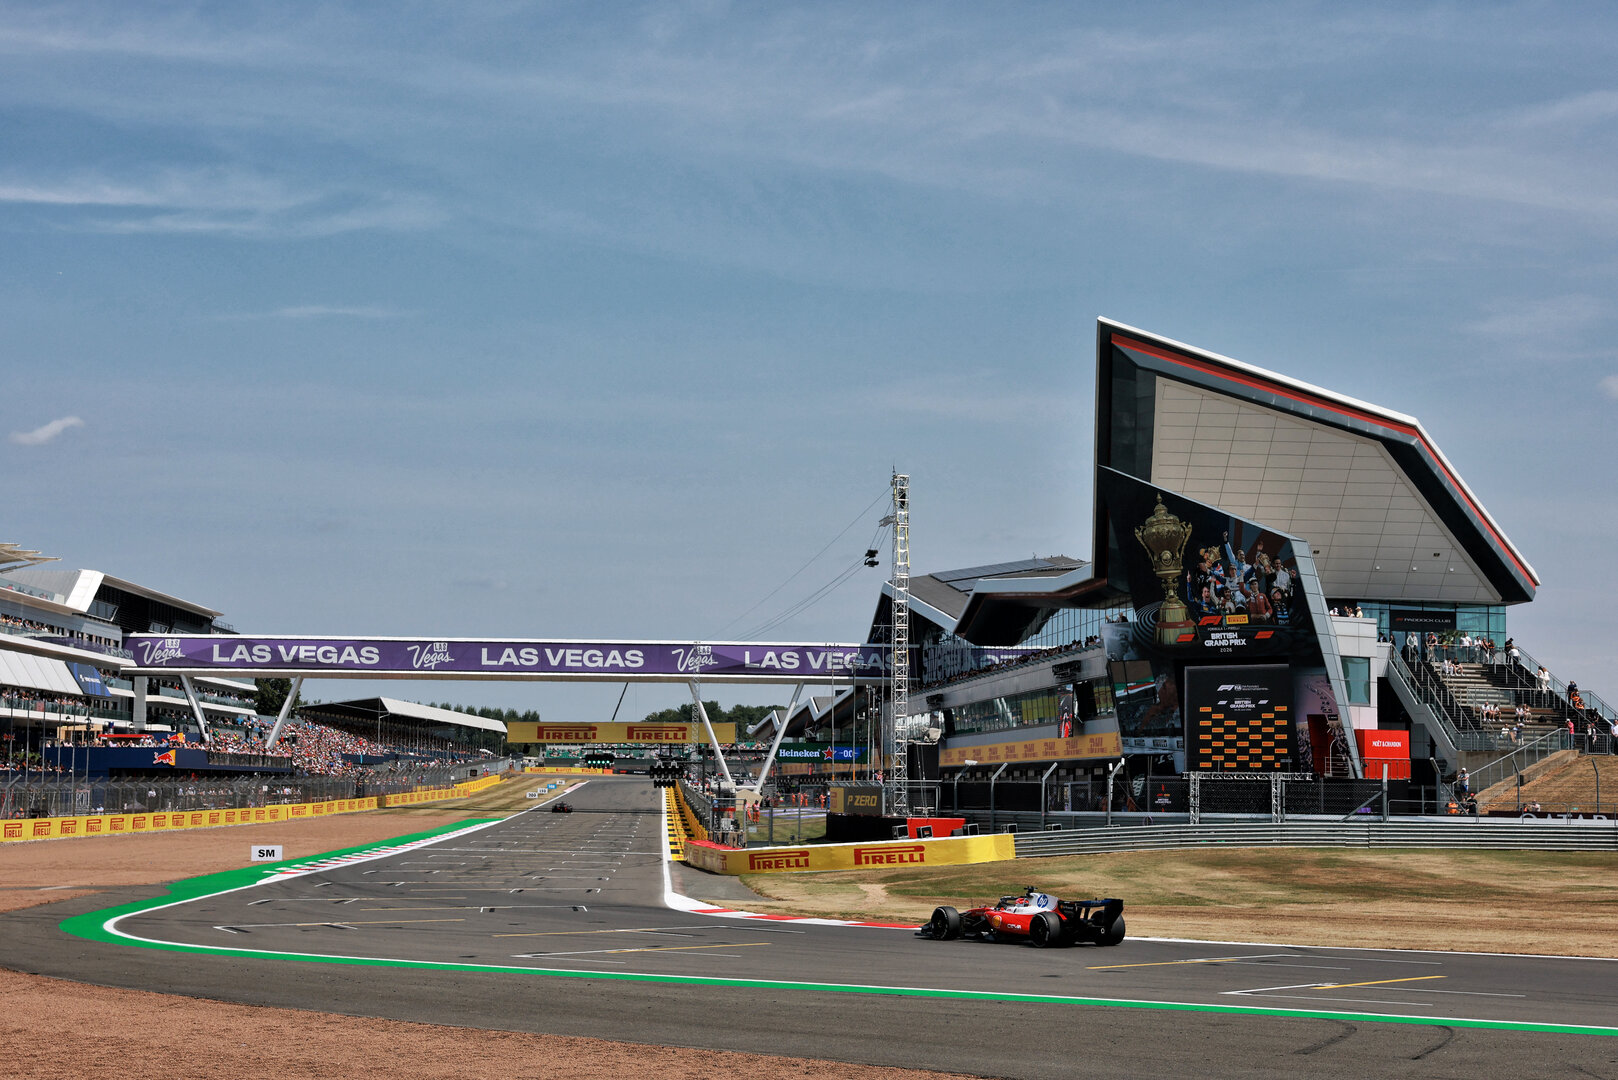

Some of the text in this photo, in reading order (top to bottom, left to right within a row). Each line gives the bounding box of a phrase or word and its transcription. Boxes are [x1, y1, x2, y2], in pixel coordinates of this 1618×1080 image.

[166, 640, 179, 648] LAS
[434, 643, 447, 652] LAS
[1229, 638, 1247, 646] PRIX
[138, 640, 186, 665] Vegas
[213, 644, 380, 664] LAS VEGAS
[407, 644, 454, 670] Vegas
[481, 648, 644, 668] LAS VEGAS
[671, 648, 718, 672] Vegas
[744, 651, 799, 669] LAS
[537, 725, 597, 740] PIRELLI
[627, 725, 687, 740] PIRELLI
[779, 749, 820, 758] Heineken
[847, 796, 854, 804] P
[854, 795, 877, 806] ZERO
[4, 823, 22, 838] PIRELLI
[33, 821, 51, 836] PIRELLI
[258, 849, 275, 858] SM
[749, 850, 809, 871] PIRELLI
[854, 845, 925, 865] PIRELLI
[1037, 895, 1048, 908] hp
